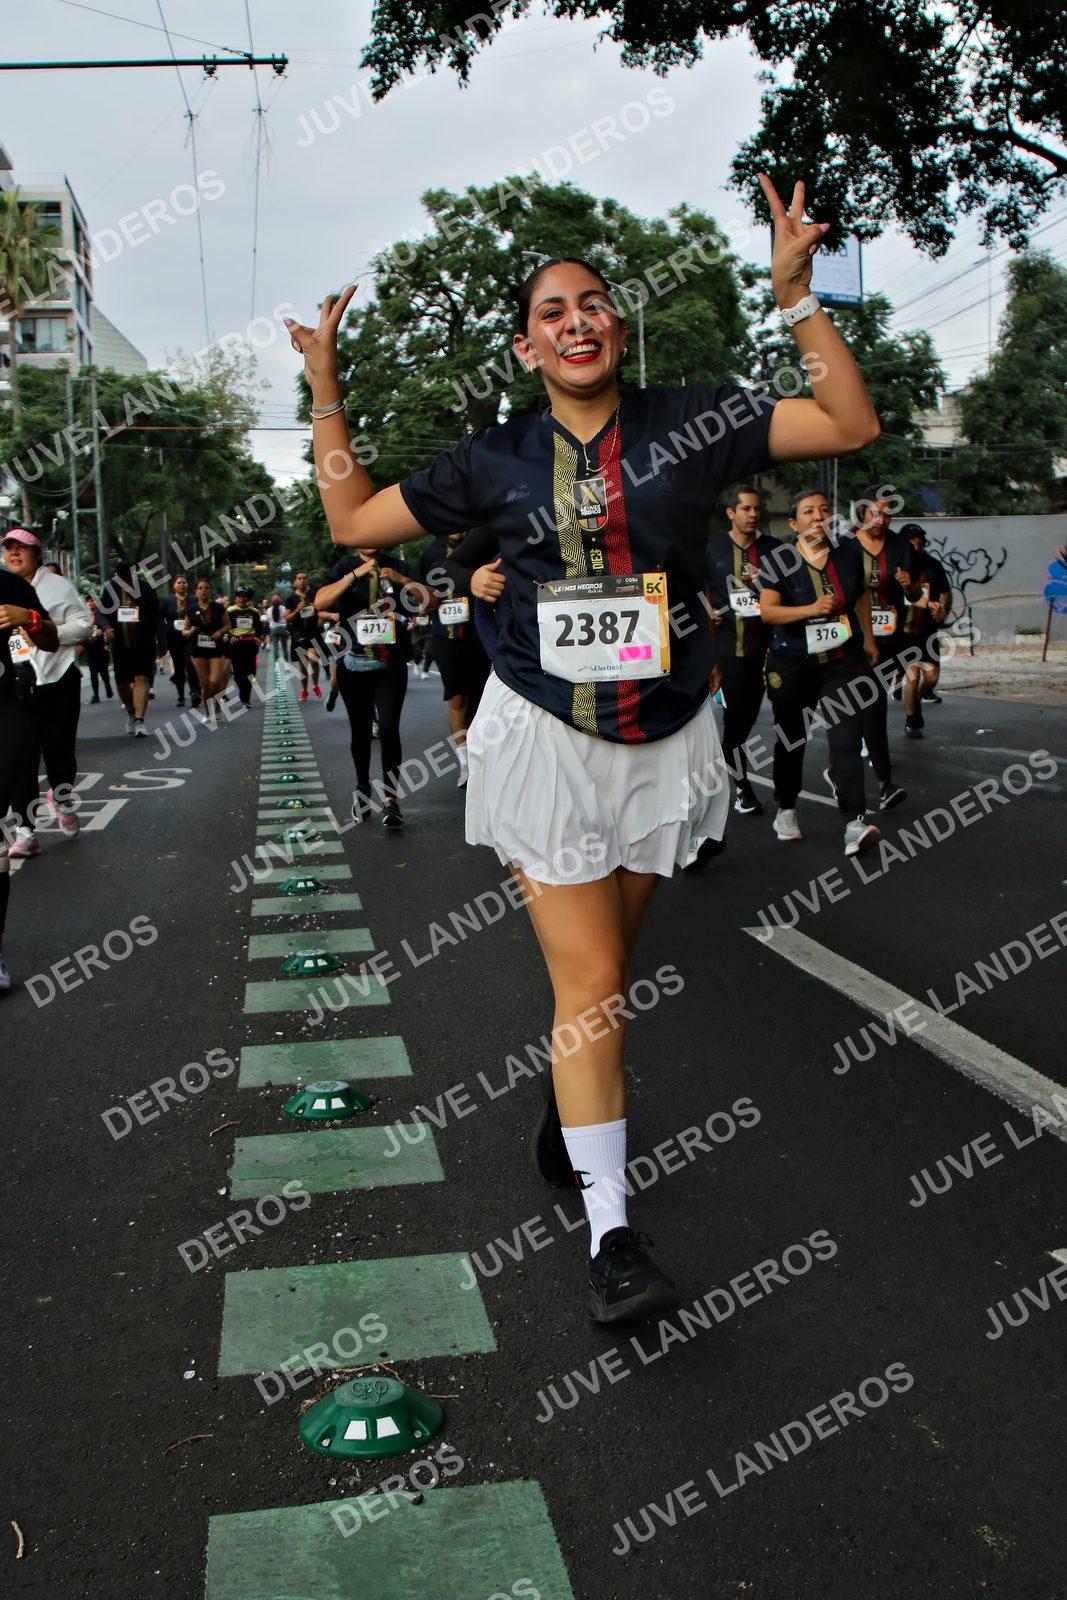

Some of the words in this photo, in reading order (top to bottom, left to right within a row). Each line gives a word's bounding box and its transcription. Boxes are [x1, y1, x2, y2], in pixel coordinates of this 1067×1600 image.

[646, 582, 662, 594] 5K
[442, 606, 463, 616] 4736
[362, 622, 388, 634] 4717
[554, 610, 640, 647] 2387
[816, 627, 839, 641] 376
